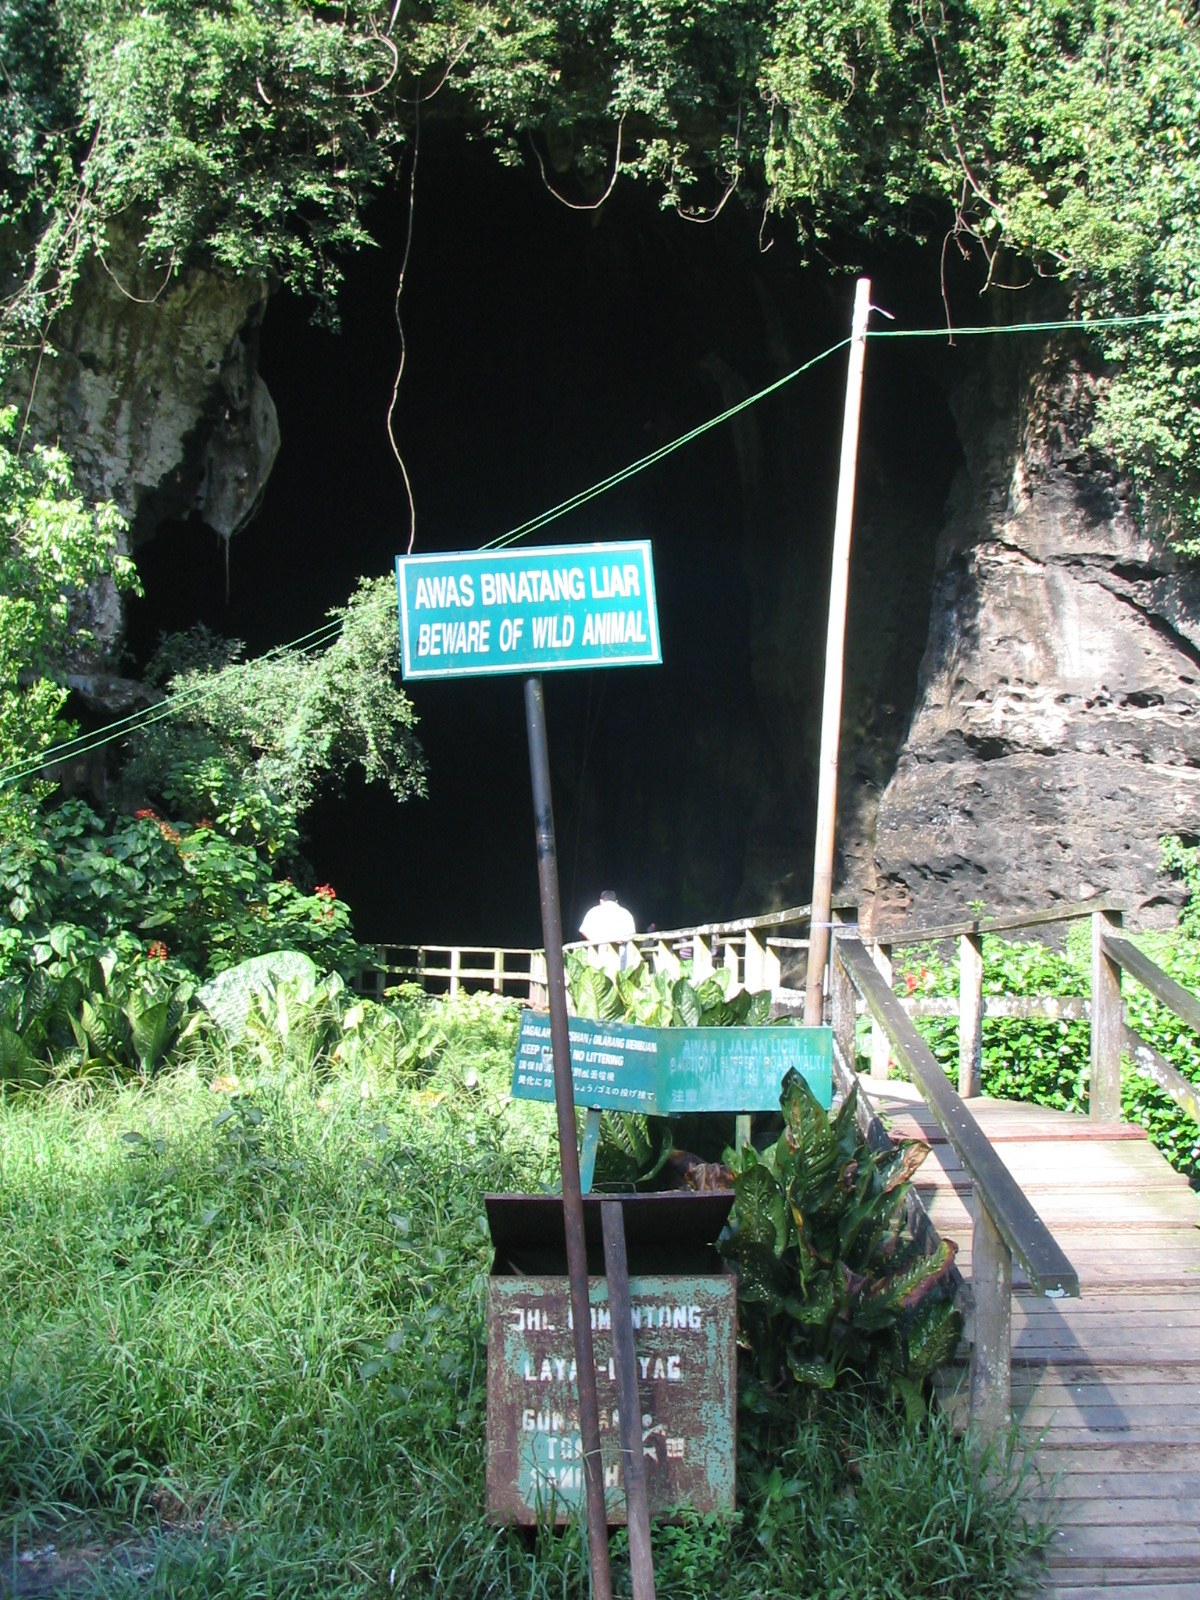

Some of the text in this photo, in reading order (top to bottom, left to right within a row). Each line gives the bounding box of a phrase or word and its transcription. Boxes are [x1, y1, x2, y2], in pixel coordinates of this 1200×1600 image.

[414, 564, 641, 610] AWAS BINATANG LIAR
[417, 611, 647, 657] BEWARE OF WILD ANIMAL
[593, 1034, 625, 1049] DILARANG
[728, 1039, 768, 1057] JALAN
[771, 1038, 800, 1056] LICIN
[521, 1043, 541, 1055] KEEP
[572, 1049, 585, 1062] NO
[585, 1051, 624, 1067] LITTERING
